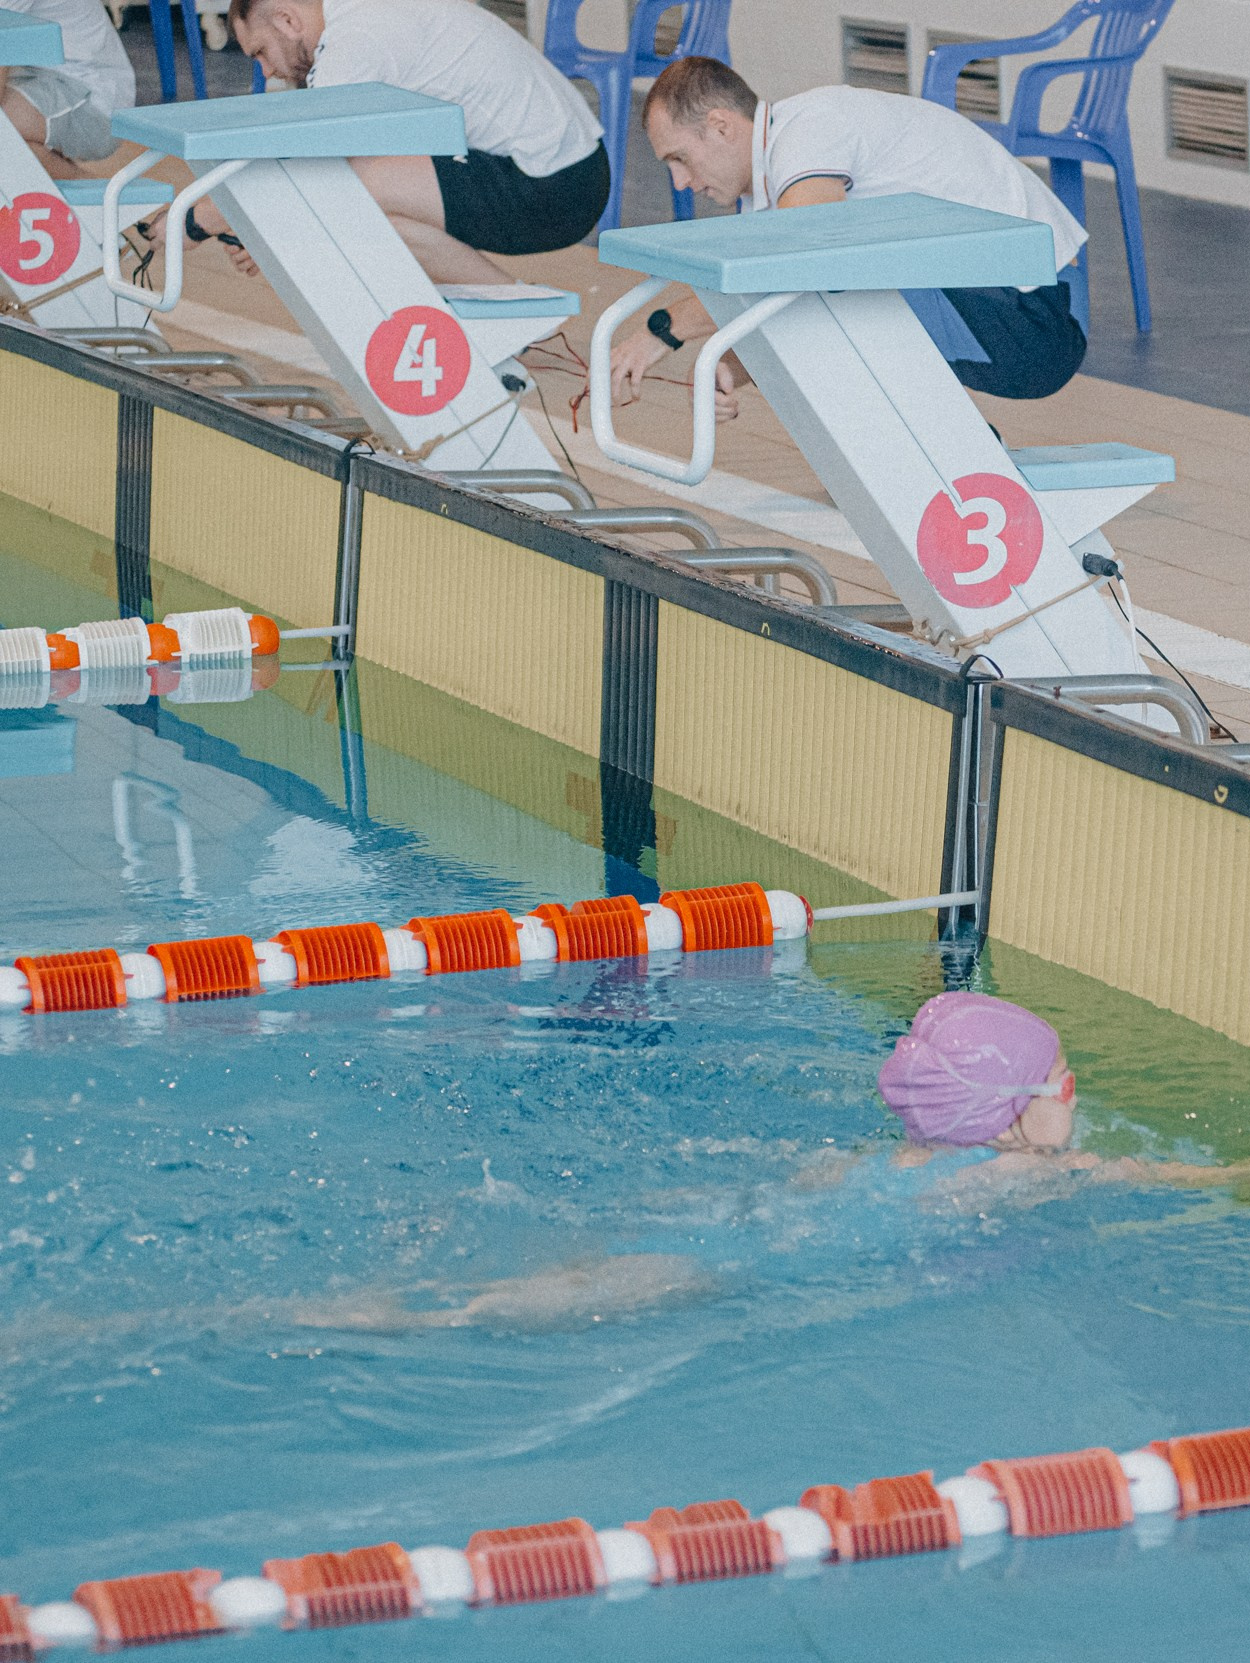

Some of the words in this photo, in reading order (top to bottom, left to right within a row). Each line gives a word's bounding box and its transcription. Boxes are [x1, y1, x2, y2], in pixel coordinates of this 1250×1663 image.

[18, 207, 55, 271] 5
[393, 323, 443, 398] 4
[952, 496, 1008, 585] 3
